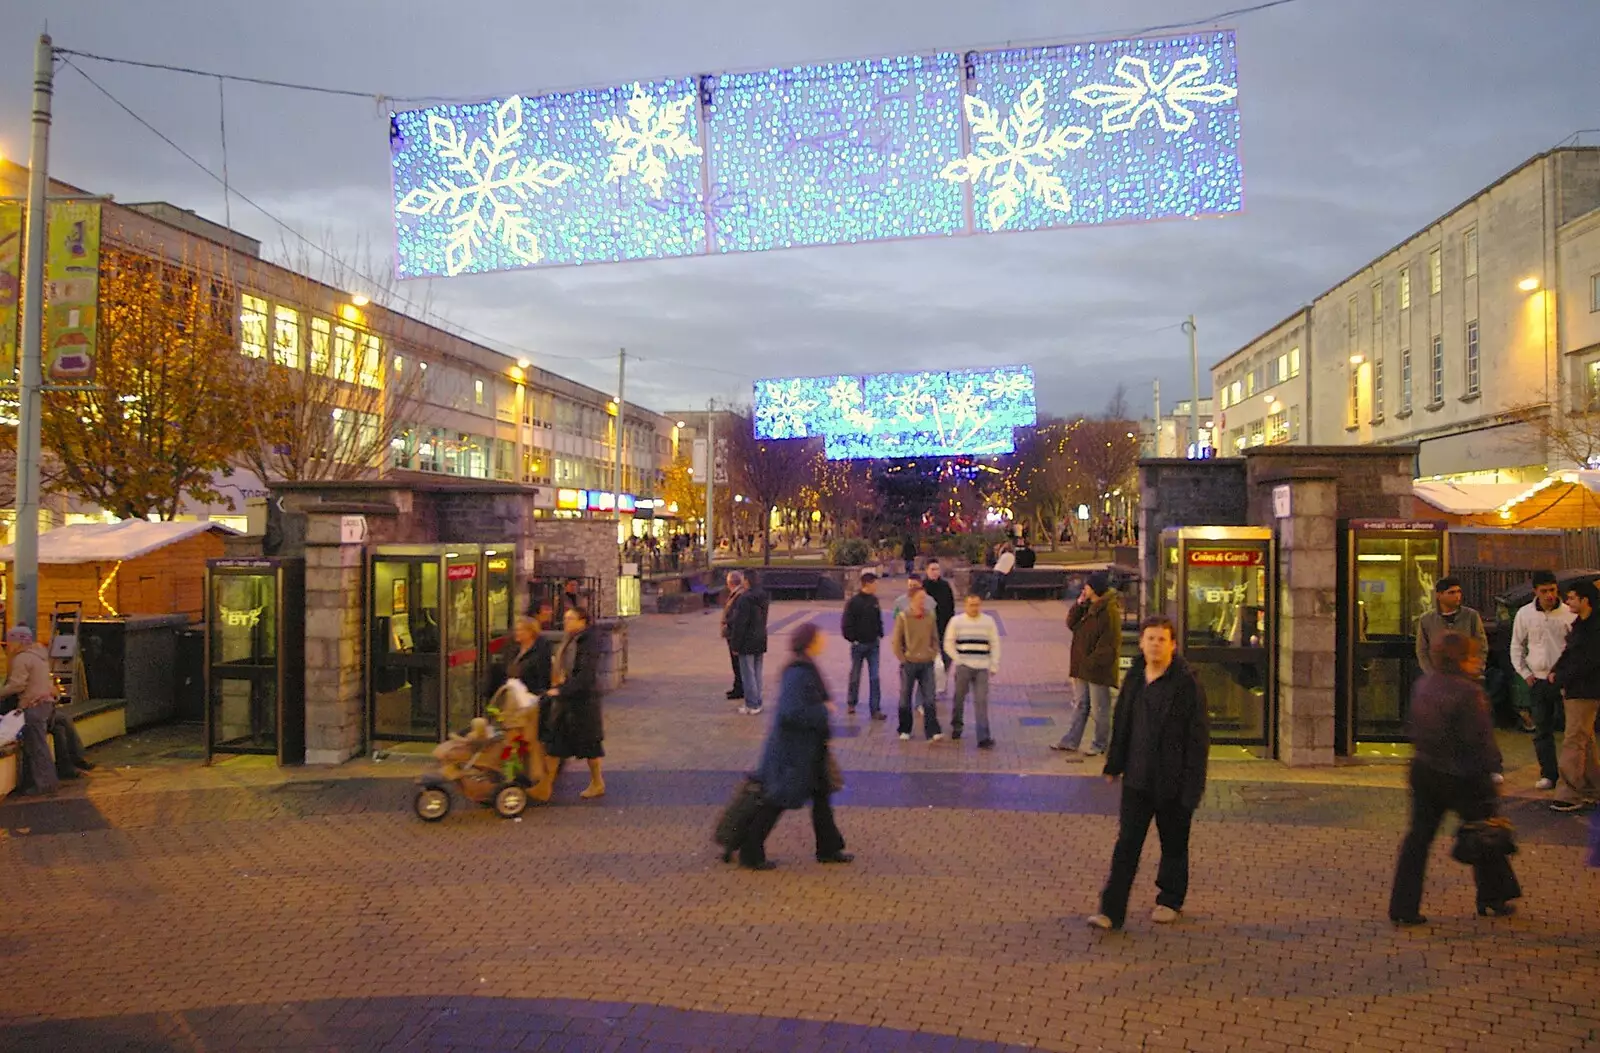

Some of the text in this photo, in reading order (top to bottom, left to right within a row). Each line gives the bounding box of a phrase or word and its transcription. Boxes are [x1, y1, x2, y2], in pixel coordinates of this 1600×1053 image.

[1191, 551, 1249, 562] Coins & Cards
[1206, 590, 1233, 604] BT
[227, 614, 250, 626] BT
